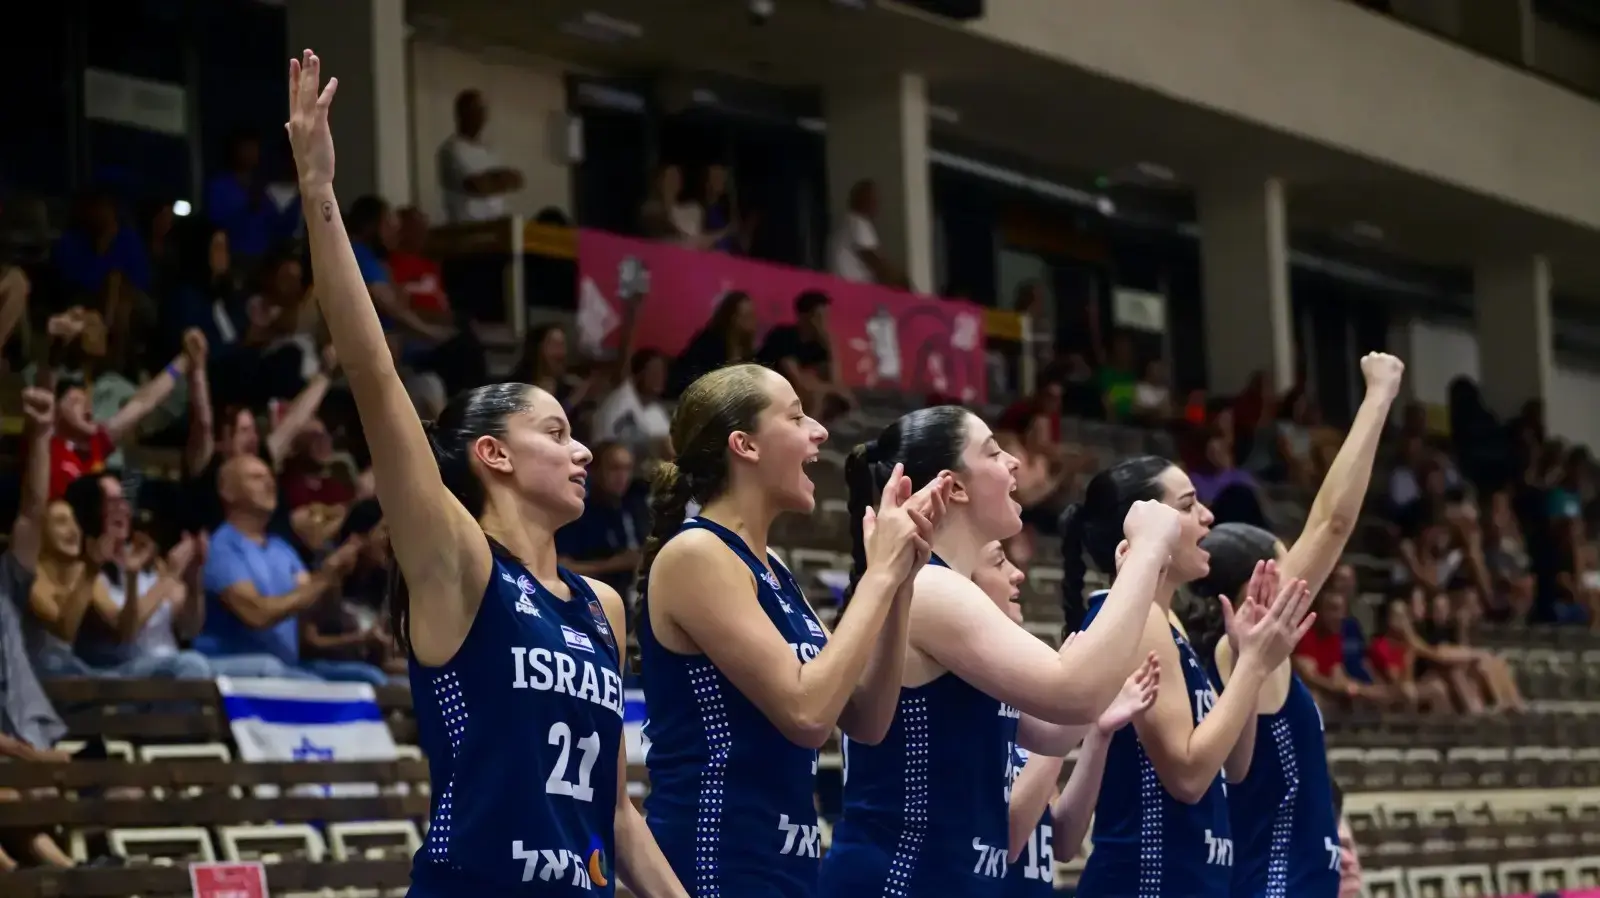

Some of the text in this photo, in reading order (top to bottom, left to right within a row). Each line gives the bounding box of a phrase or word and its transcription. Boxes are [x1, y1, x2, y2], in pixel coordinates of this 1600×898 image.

[511, 646, 625, 719] ISRAEL
[546, 721, 600, 802] 21
[1023, 824, 1054, 883] 15
[1204, 829, 1234, 867] ראל
